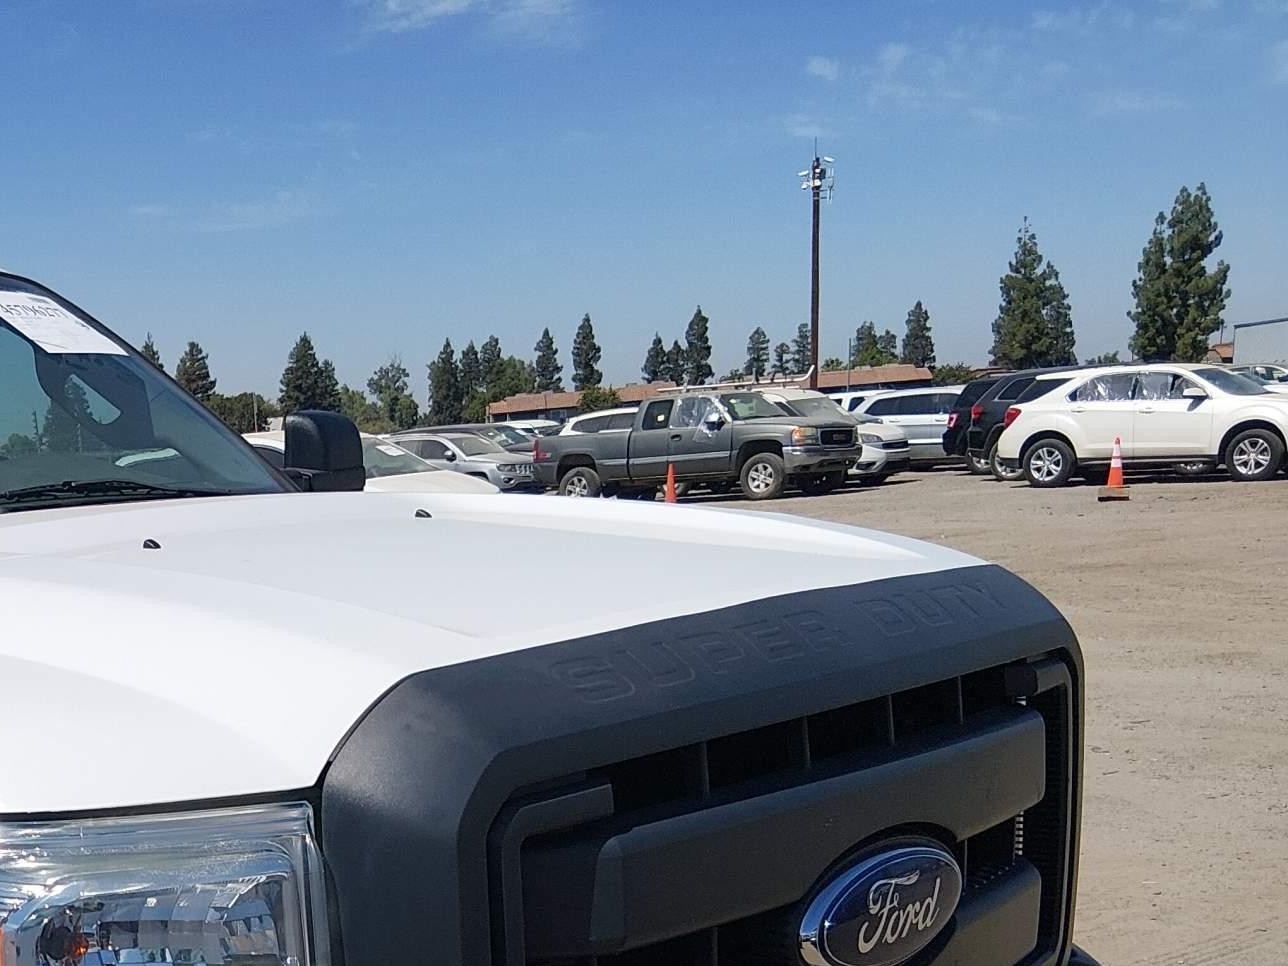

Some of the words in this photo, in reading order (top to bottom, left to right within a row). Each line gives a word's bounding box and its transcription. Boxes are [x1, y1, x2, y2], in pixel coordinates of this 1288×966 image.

[546, 609, 853, 704] SUPER
[853, 582, 1010, 639] DUTY
[857, 869, 941, 954] Ford
